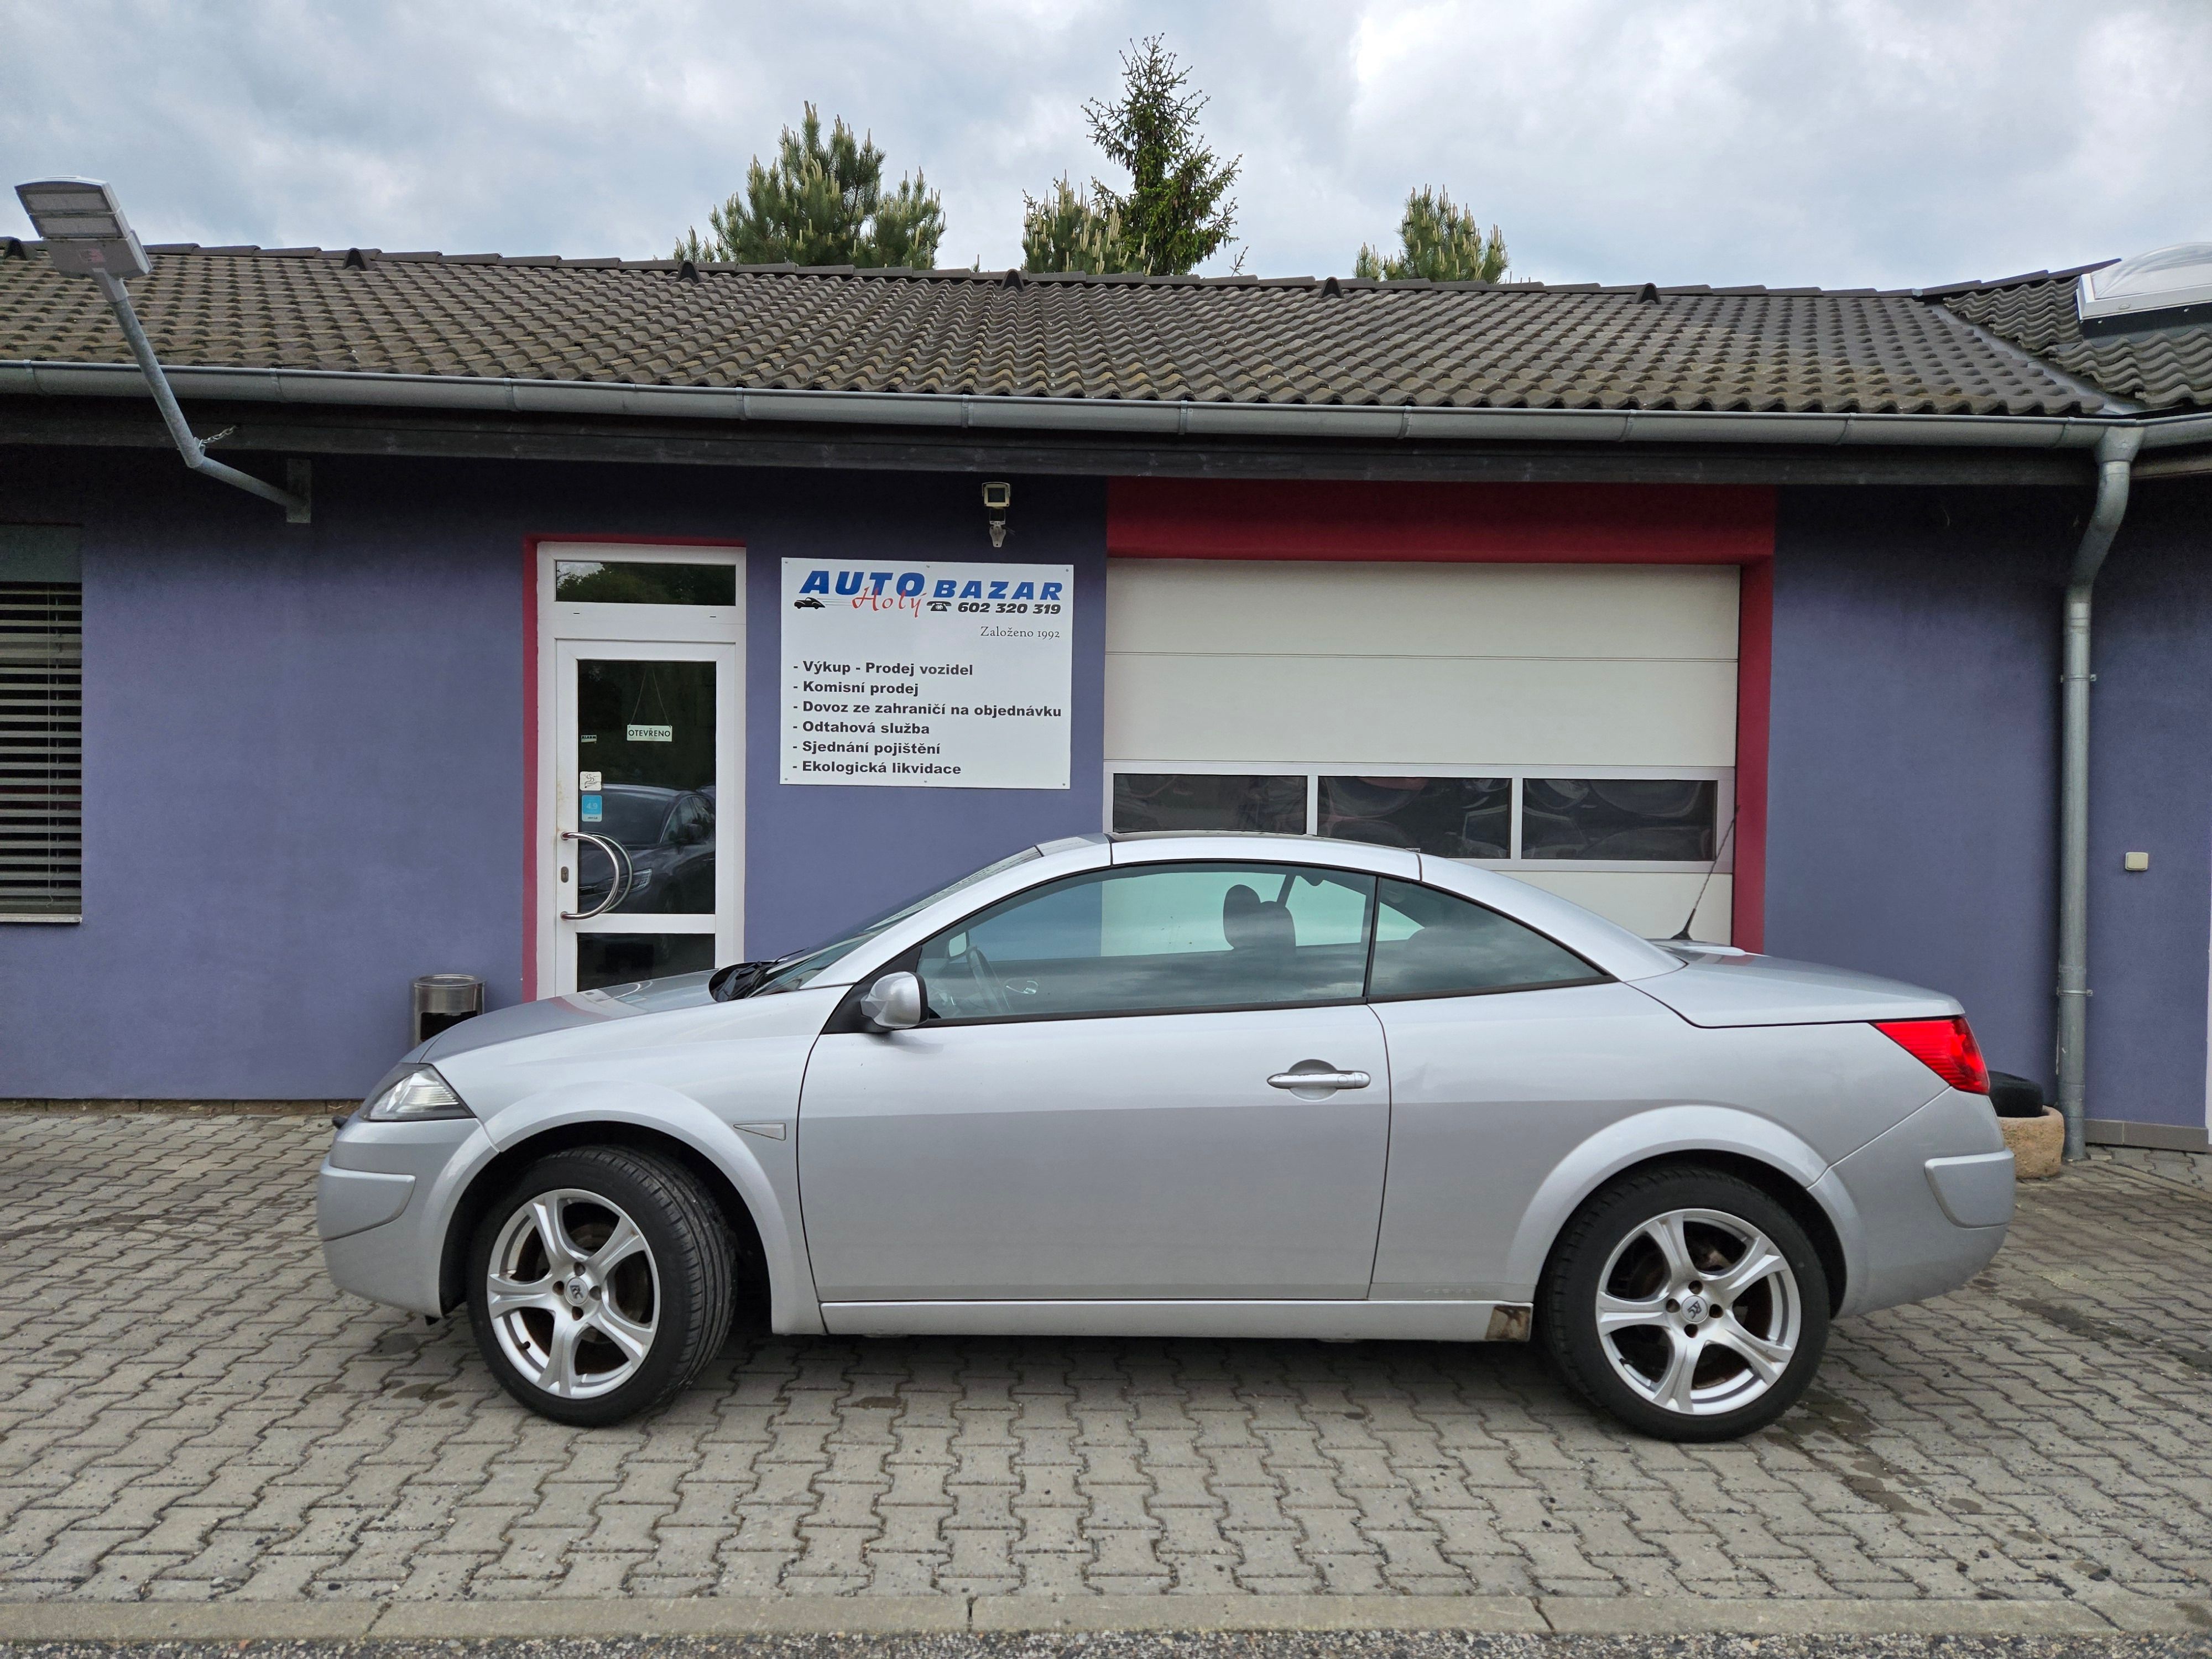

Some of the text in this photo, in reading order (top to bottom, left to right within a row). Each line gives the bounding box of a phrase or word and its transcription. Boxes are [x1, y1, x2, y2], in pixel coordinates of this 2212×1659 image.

[799, 570, 1062, 600] AUTO BAZAR
[852, 587, 927, 618] Holý
[958, 602, 1061, 614] 602 320 319
[980, 626, 1060, 640] Založeno 1992
[803, 661, 851, 675] Výkup
[865, 662, 915, 677] Prodej
[920, 664, 973, 675] vozidel
[803, 681, 865, 692] Komisní
[870, 683, 919, 697] prodej
[803, 701, 848, 712] Dovoz
[853, 705, 870, 713] ze
[875, 703, 946, 714] zahraničí
[951, 706, 969, 715] na
[974, 705, 1061, 718] objednávku
[628, 728, 671, 737] OTEVŘENO
[802, 721, 875, 733] Odtahová
[880, 722, 930, 734] služba
[802, 741, 869, 754] Sjednání
[874, 743, 941, 756] pojištění
[802, 761, 886, 775] Ekologická
[892, 762, 962, 774] likvidace
